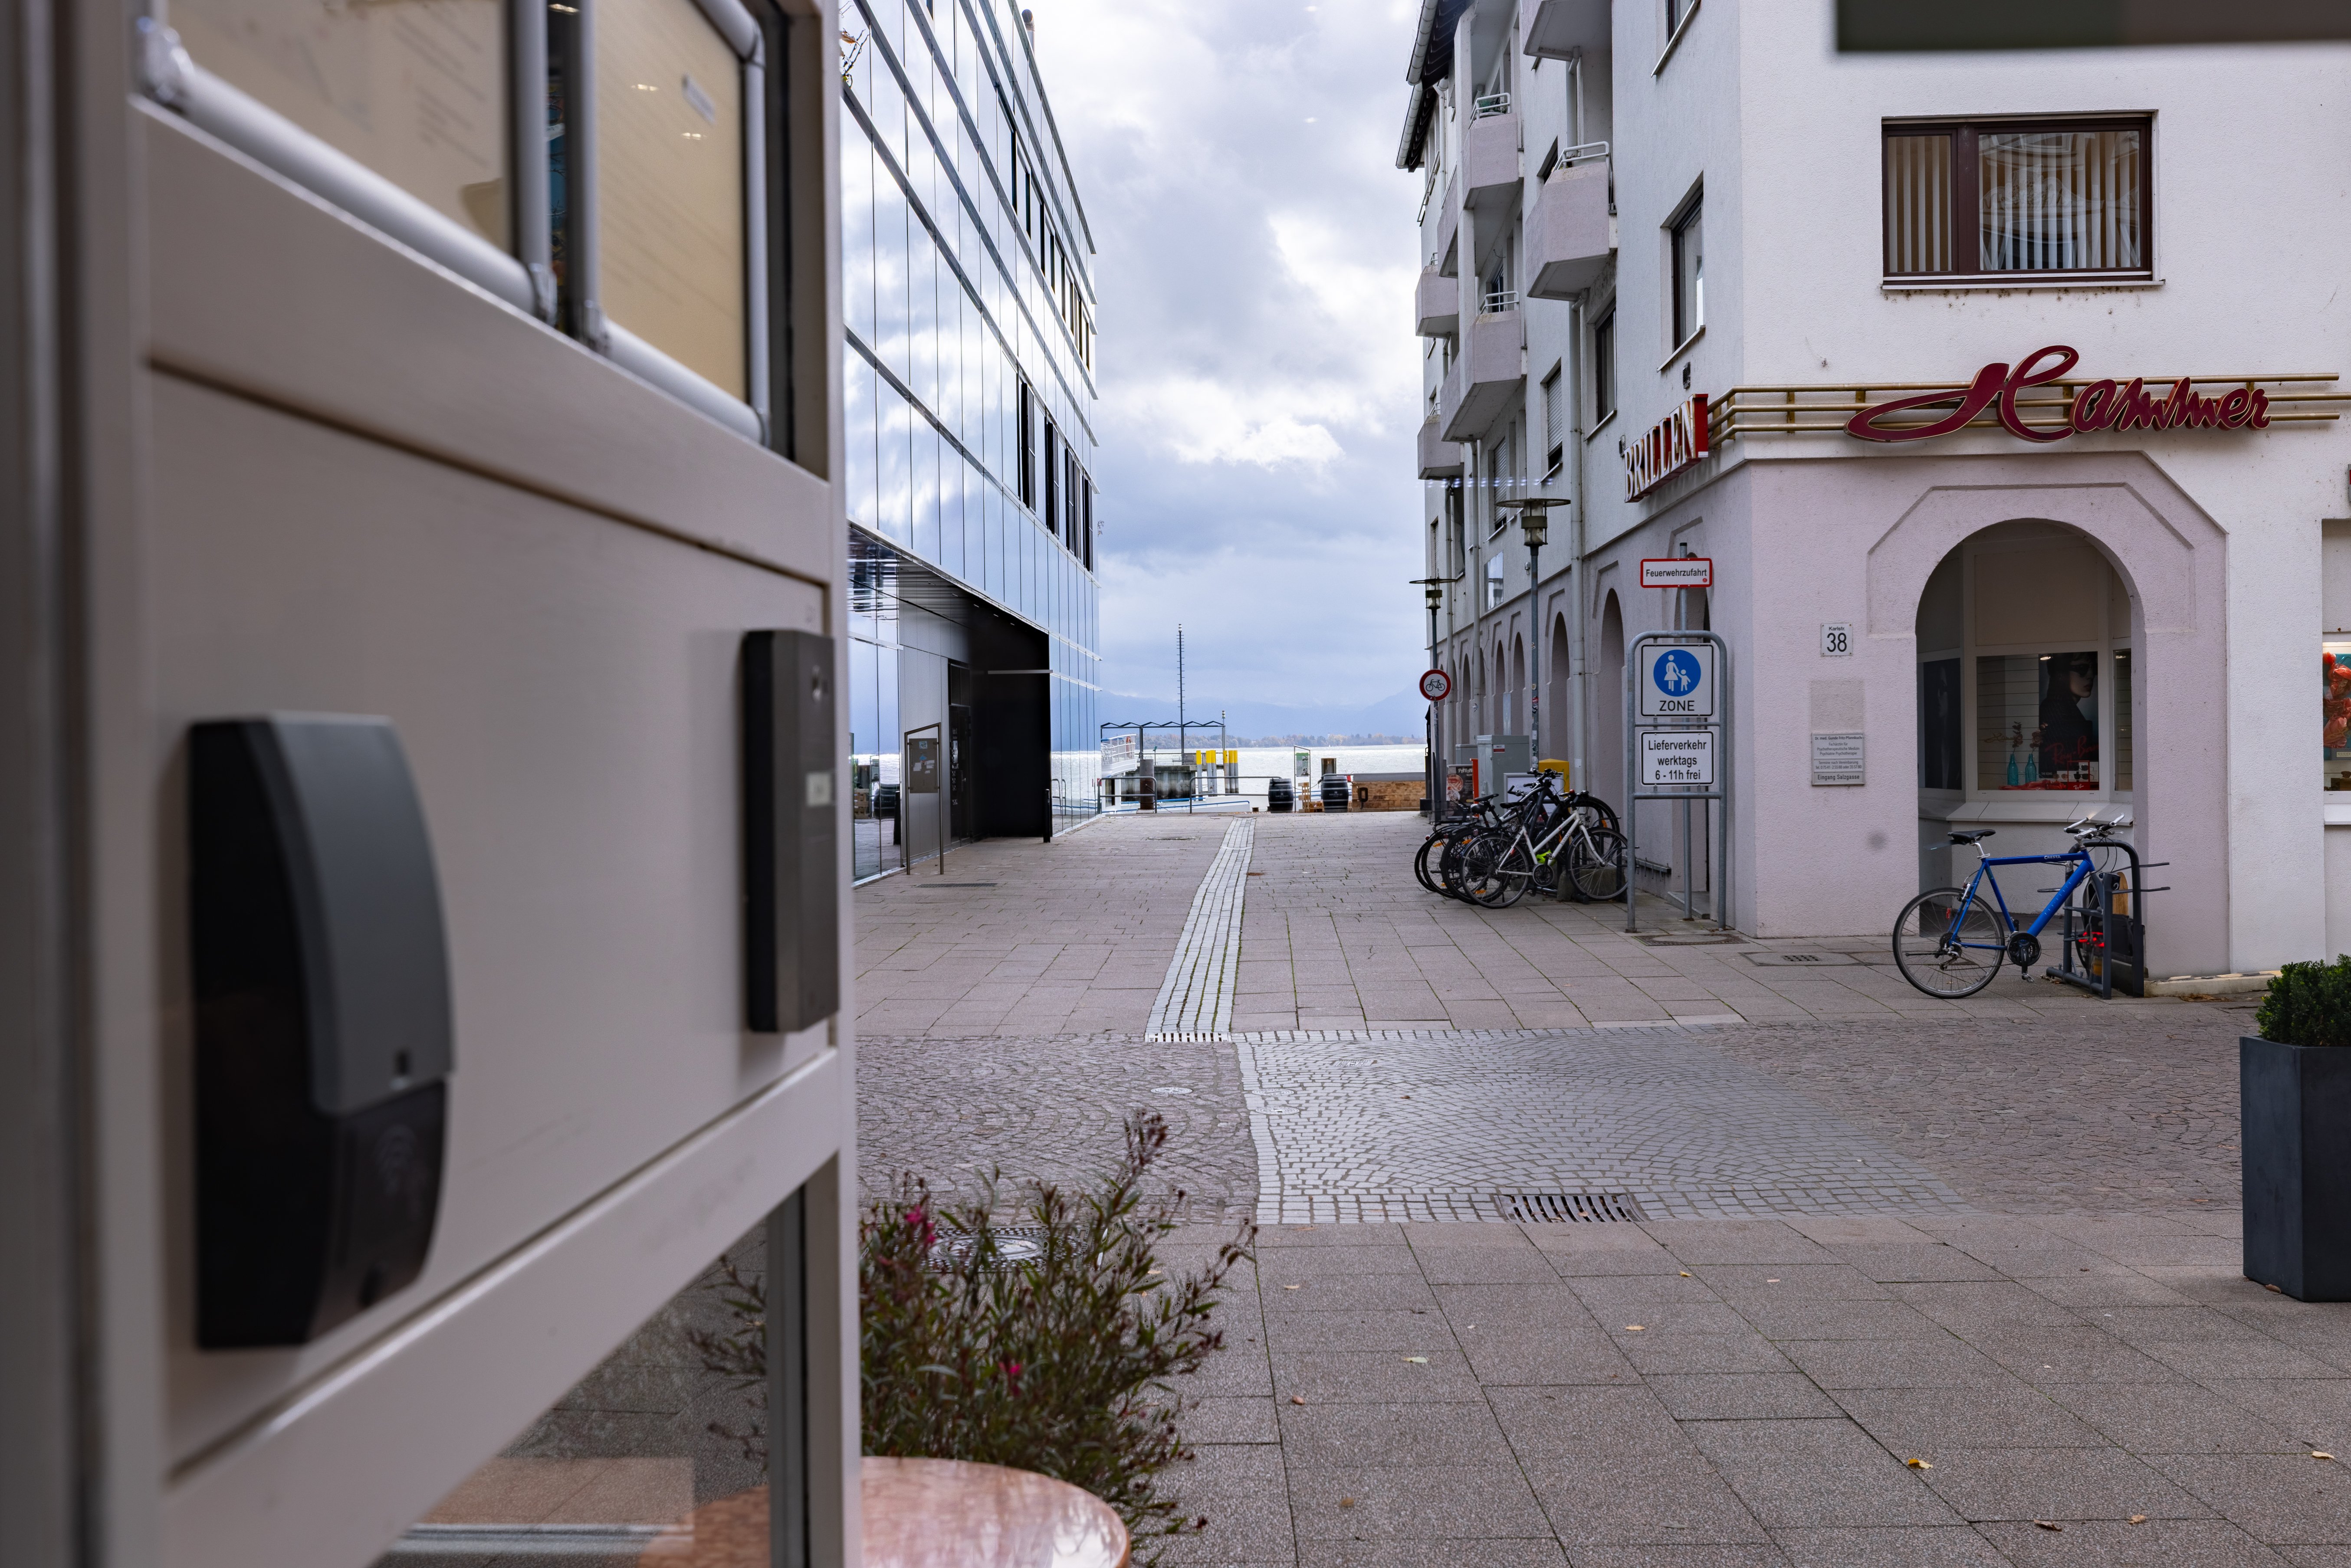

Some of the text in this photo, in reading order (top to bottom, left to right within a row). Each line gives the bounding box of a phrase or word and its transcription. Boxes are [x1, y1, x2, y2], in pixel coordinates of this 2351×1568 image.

[1624, 394, 1708, 503] BRILLEN
[1646, 568, 1707, 577] Feuerwehrzufahrt
[1827, 633, 1847, 652] 38
[1659, 700, 1695, 711] ZONE
[1648, 740, 1707, 750] Lieferverkehr
[1657, 755, 1697, 768] werktags
[1655, 770, 1660, 780] 6
[1669, 770, 1684, 780] 11h
[1687, 770, 1701, 779] frei
